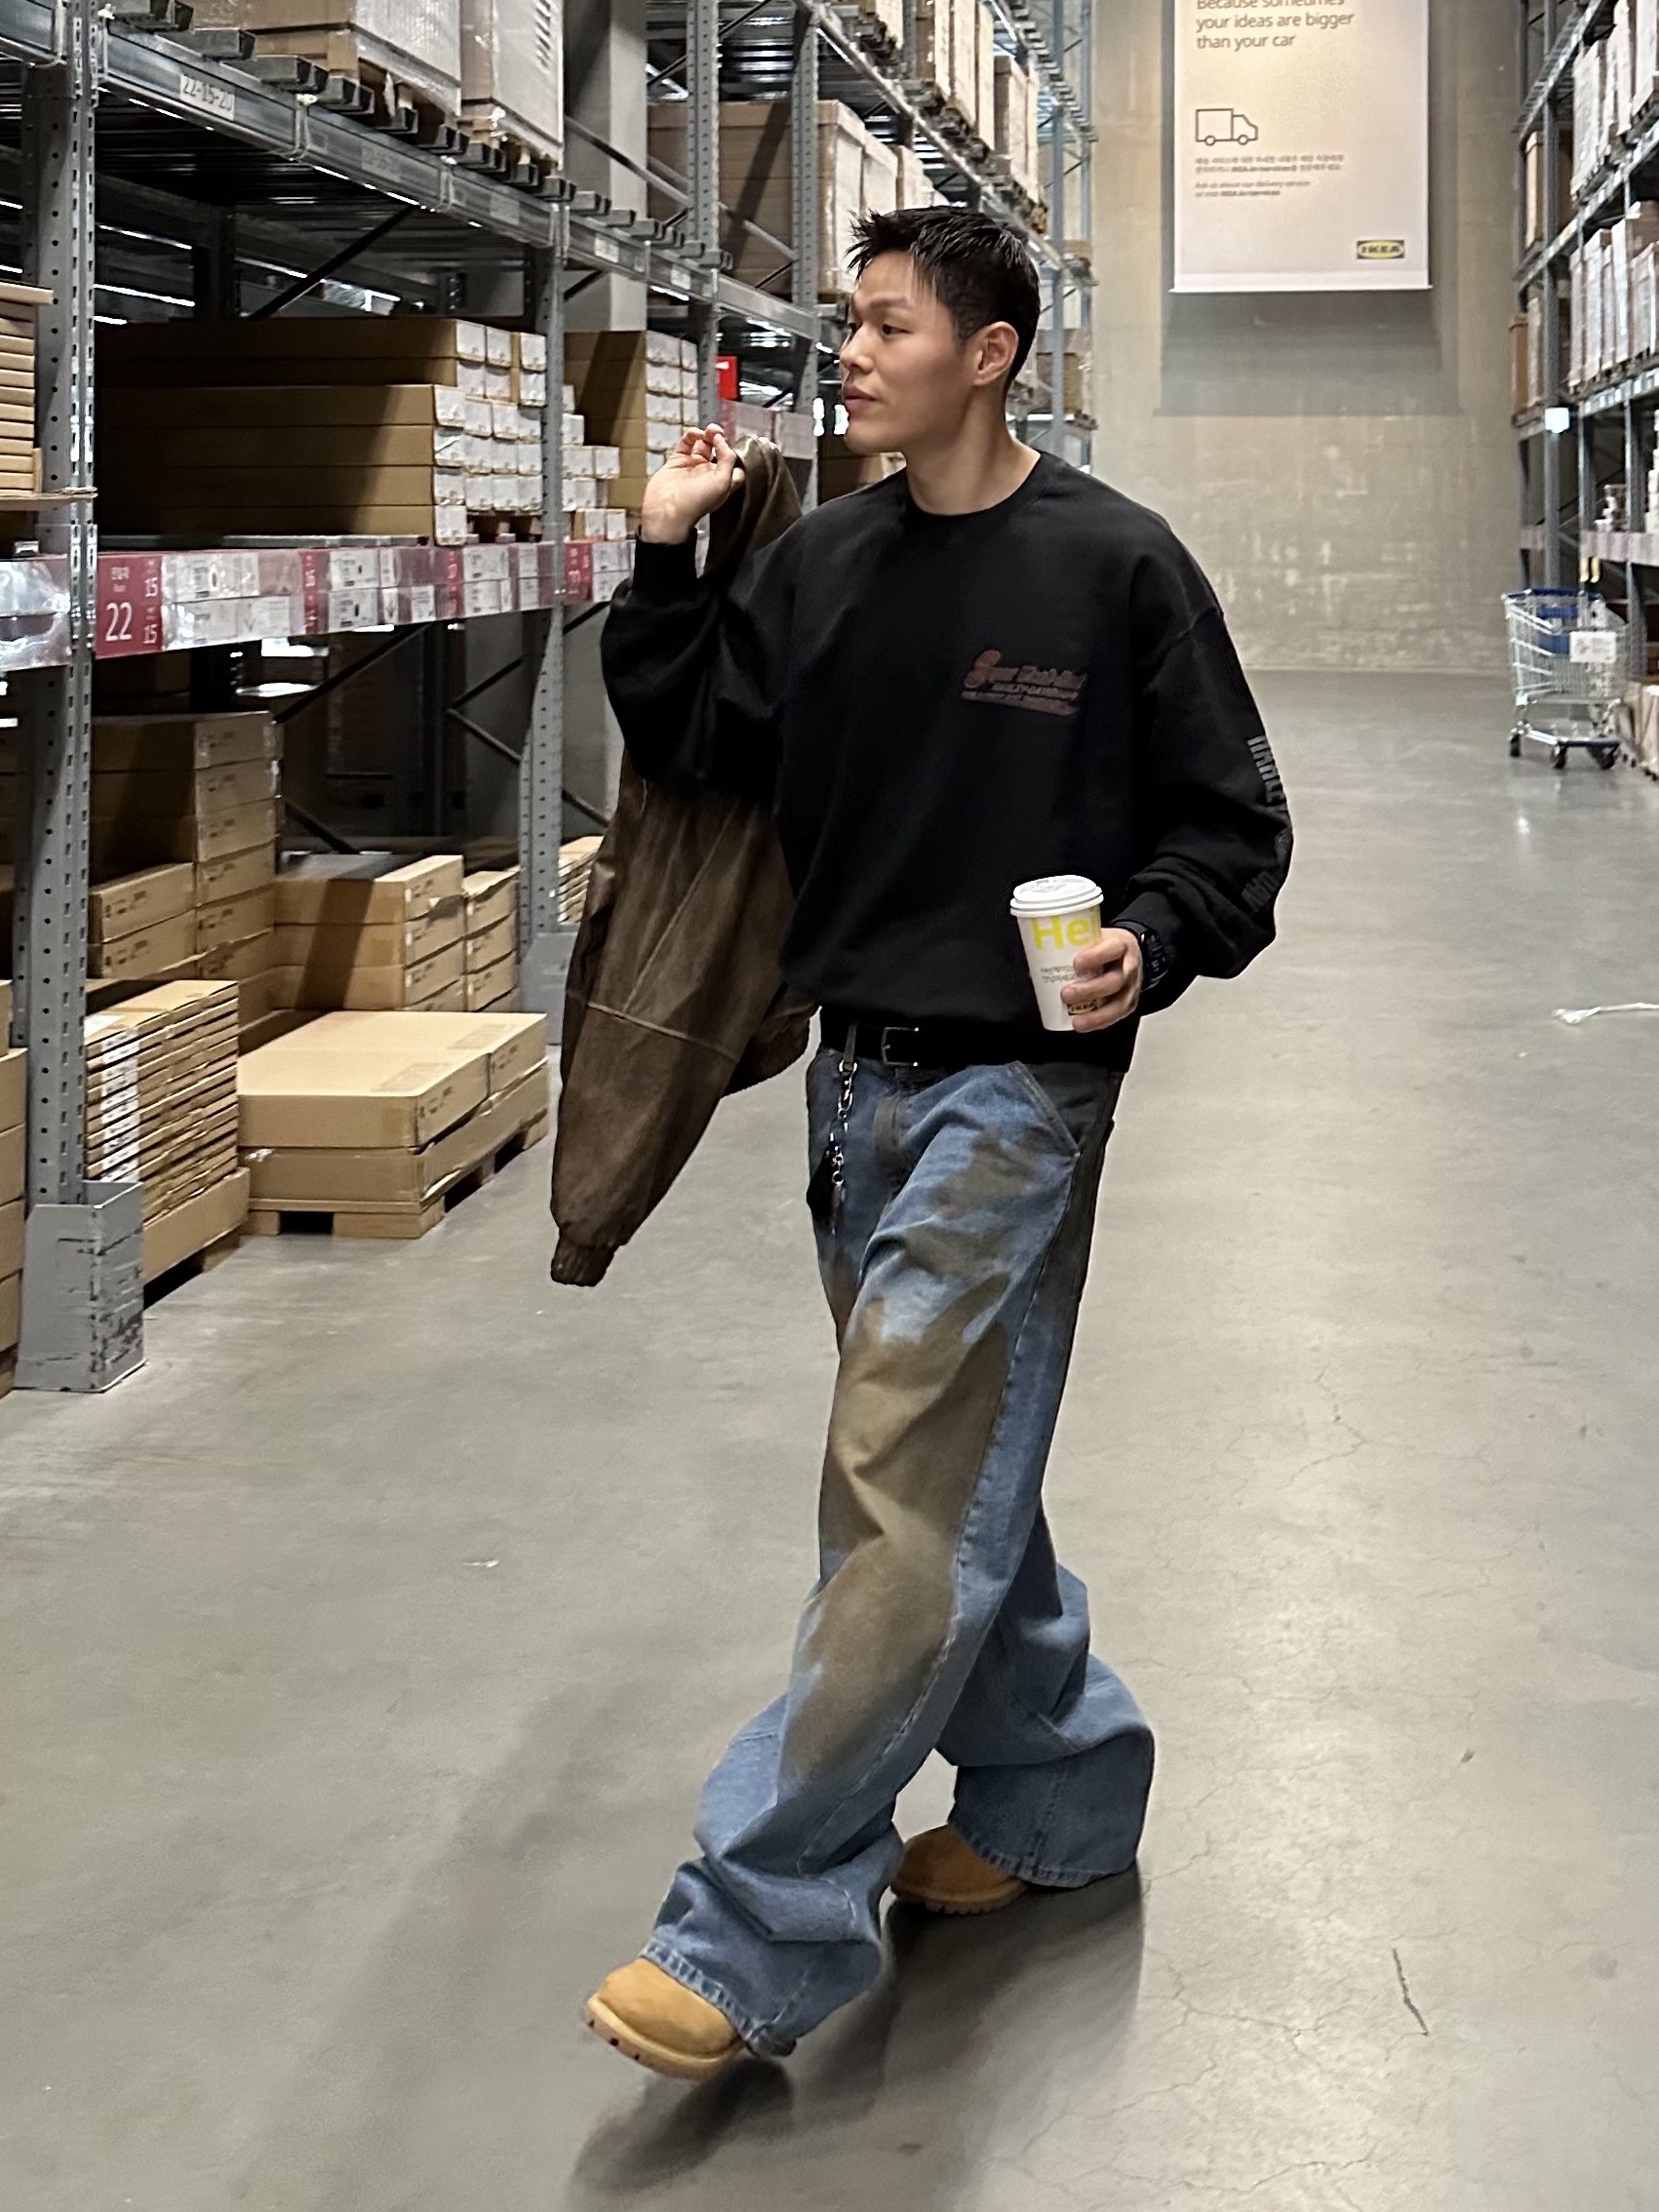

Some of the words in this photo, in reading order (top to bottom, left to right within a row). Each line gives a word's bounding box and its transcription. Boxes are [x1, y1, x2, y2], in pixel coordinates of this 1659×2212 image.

[1196, 0, 1258, 10] Because
[1196, 18, 1231, 33] your
[1234, 14, 1274, 28] ideas
[1276, 15, 1302, 27] are
[1305, 12, 1355, 30] bigger
[1196, 35, 1231, 50] than
[1234, 36, 1269, 52] your
[1272, 35, 1296, 47] car
[144, 576, 158, 597] 15
[104, 602, 133, 642] 22
[142, 622, 158, 645] 15
